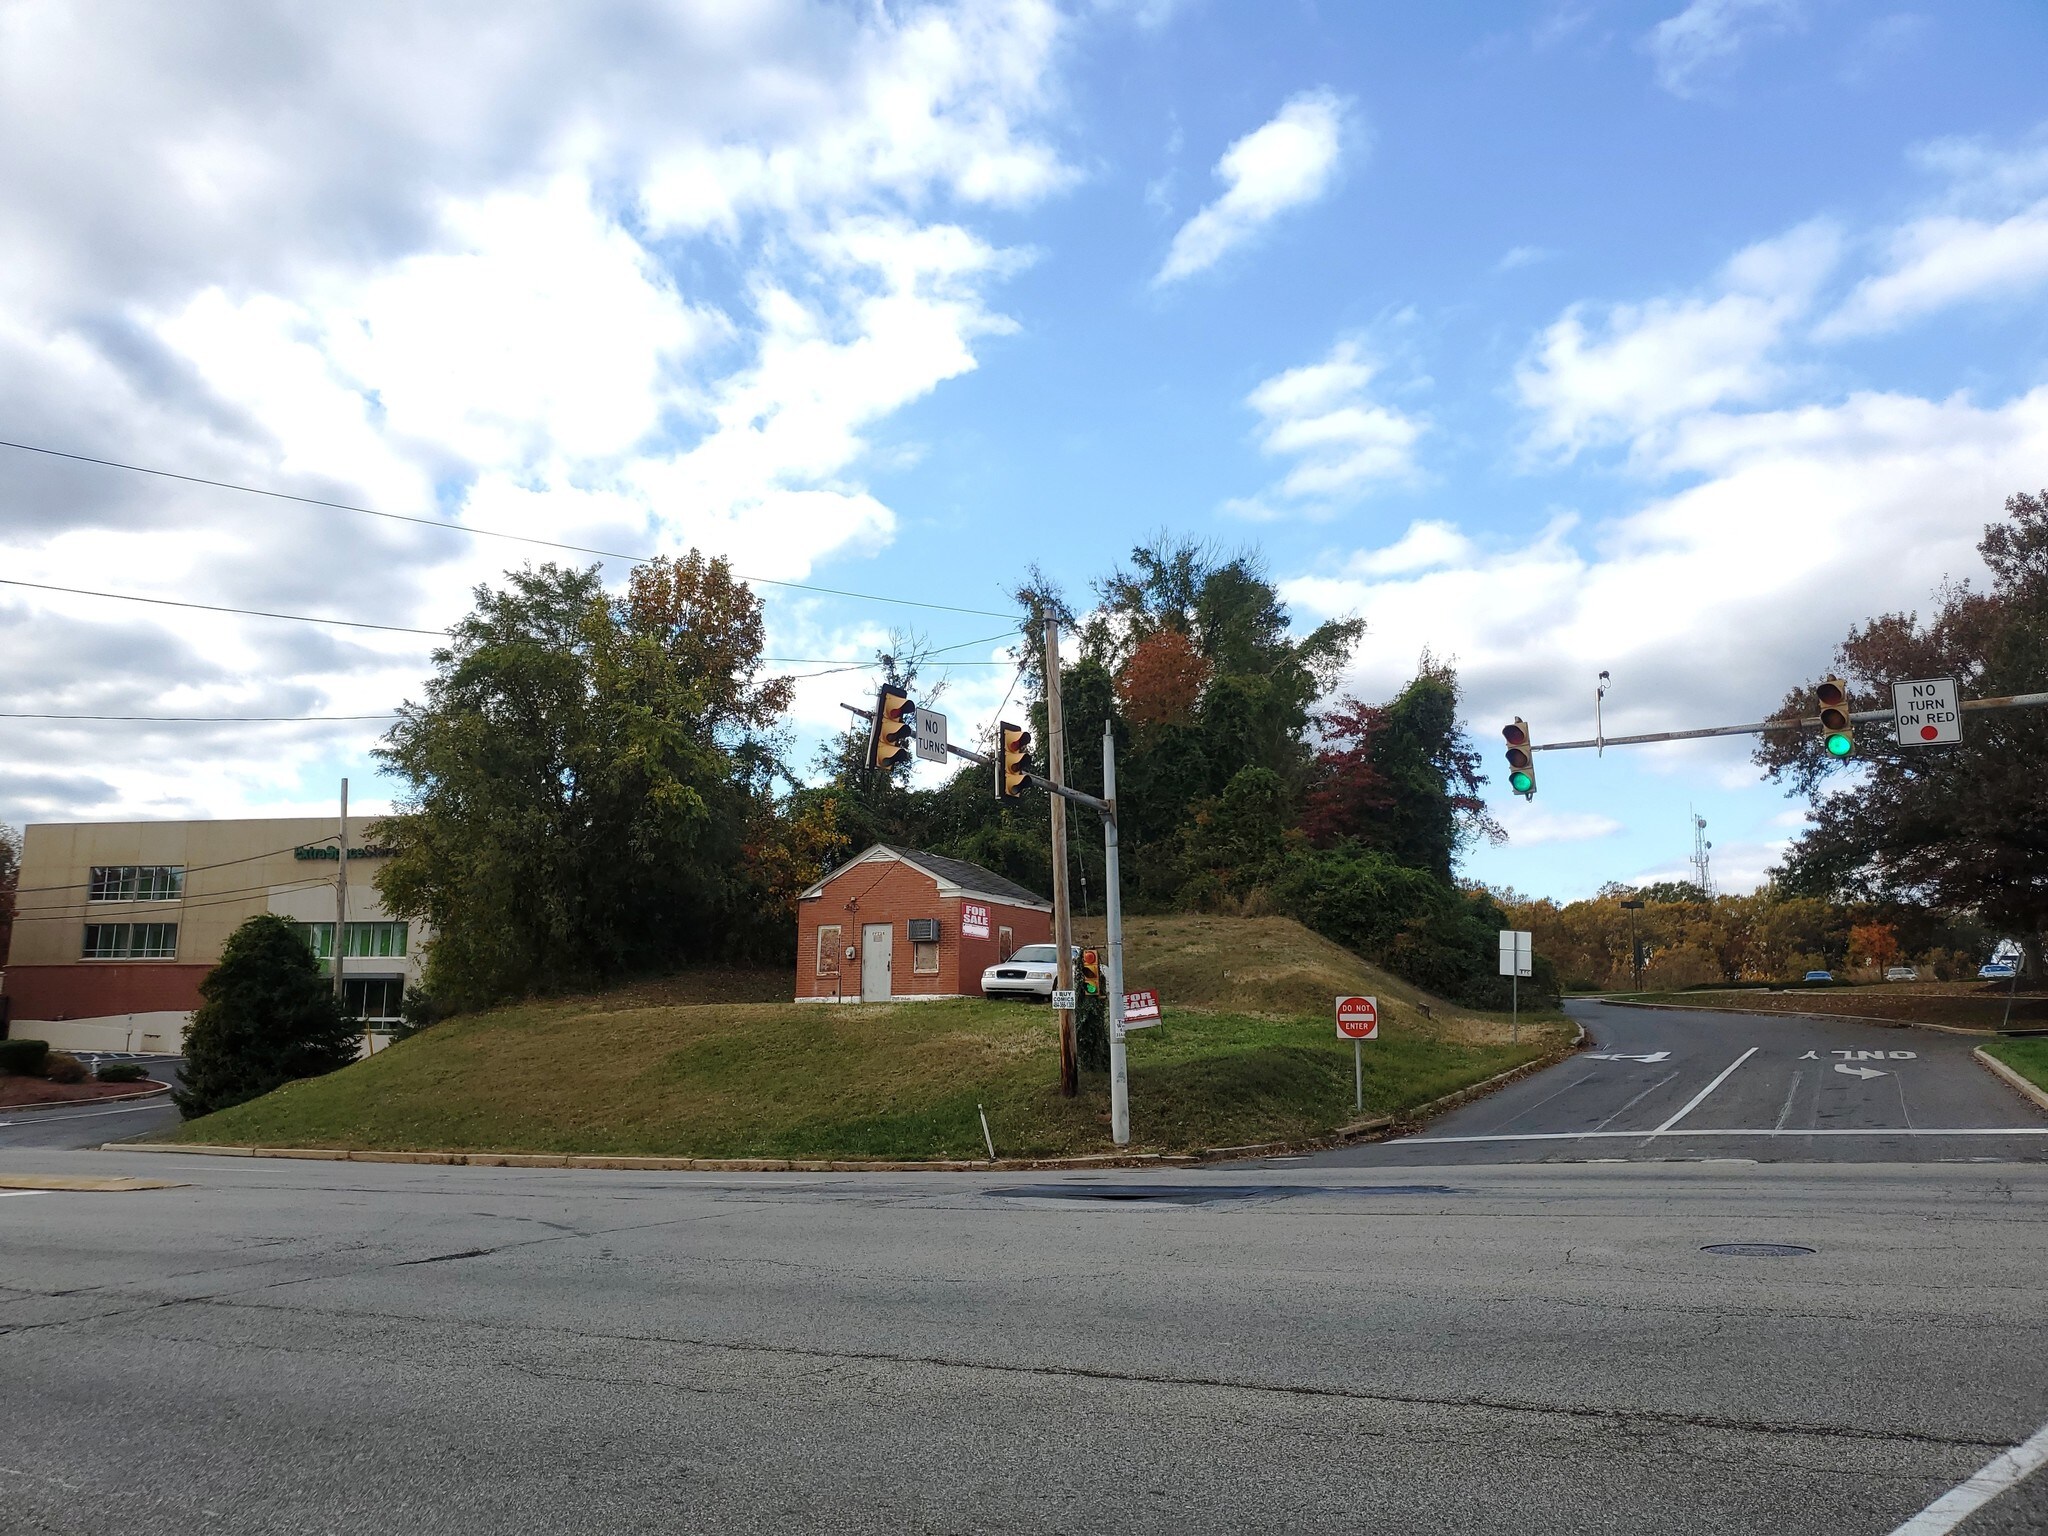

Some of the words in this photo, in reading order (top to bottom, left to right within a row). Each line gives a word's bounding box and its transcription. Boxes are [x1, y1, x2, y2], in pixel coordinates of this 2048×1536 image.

[1912, 684, 1936, 698] NO
[1907, 699, 1945, 711] TURN
[1900, 714, 1920, 726] ON
[1926, 711, 1955, 724] RED
[925, 719, 938, 734] NO
[918, 737, 945, 755] TURNS
[965, 905, 986, 917] FOR
[963, 913, 989, 926] SALE
[1123, 992, 1152, 1003] FOR
[1342, 1004, 1352, 1012] DO
[1356, 1004, 1371, 1012] NOT
[1345, 1022, 1369, 1030] ENTER
[1798, 1050, 1918, 1061] ONLY
